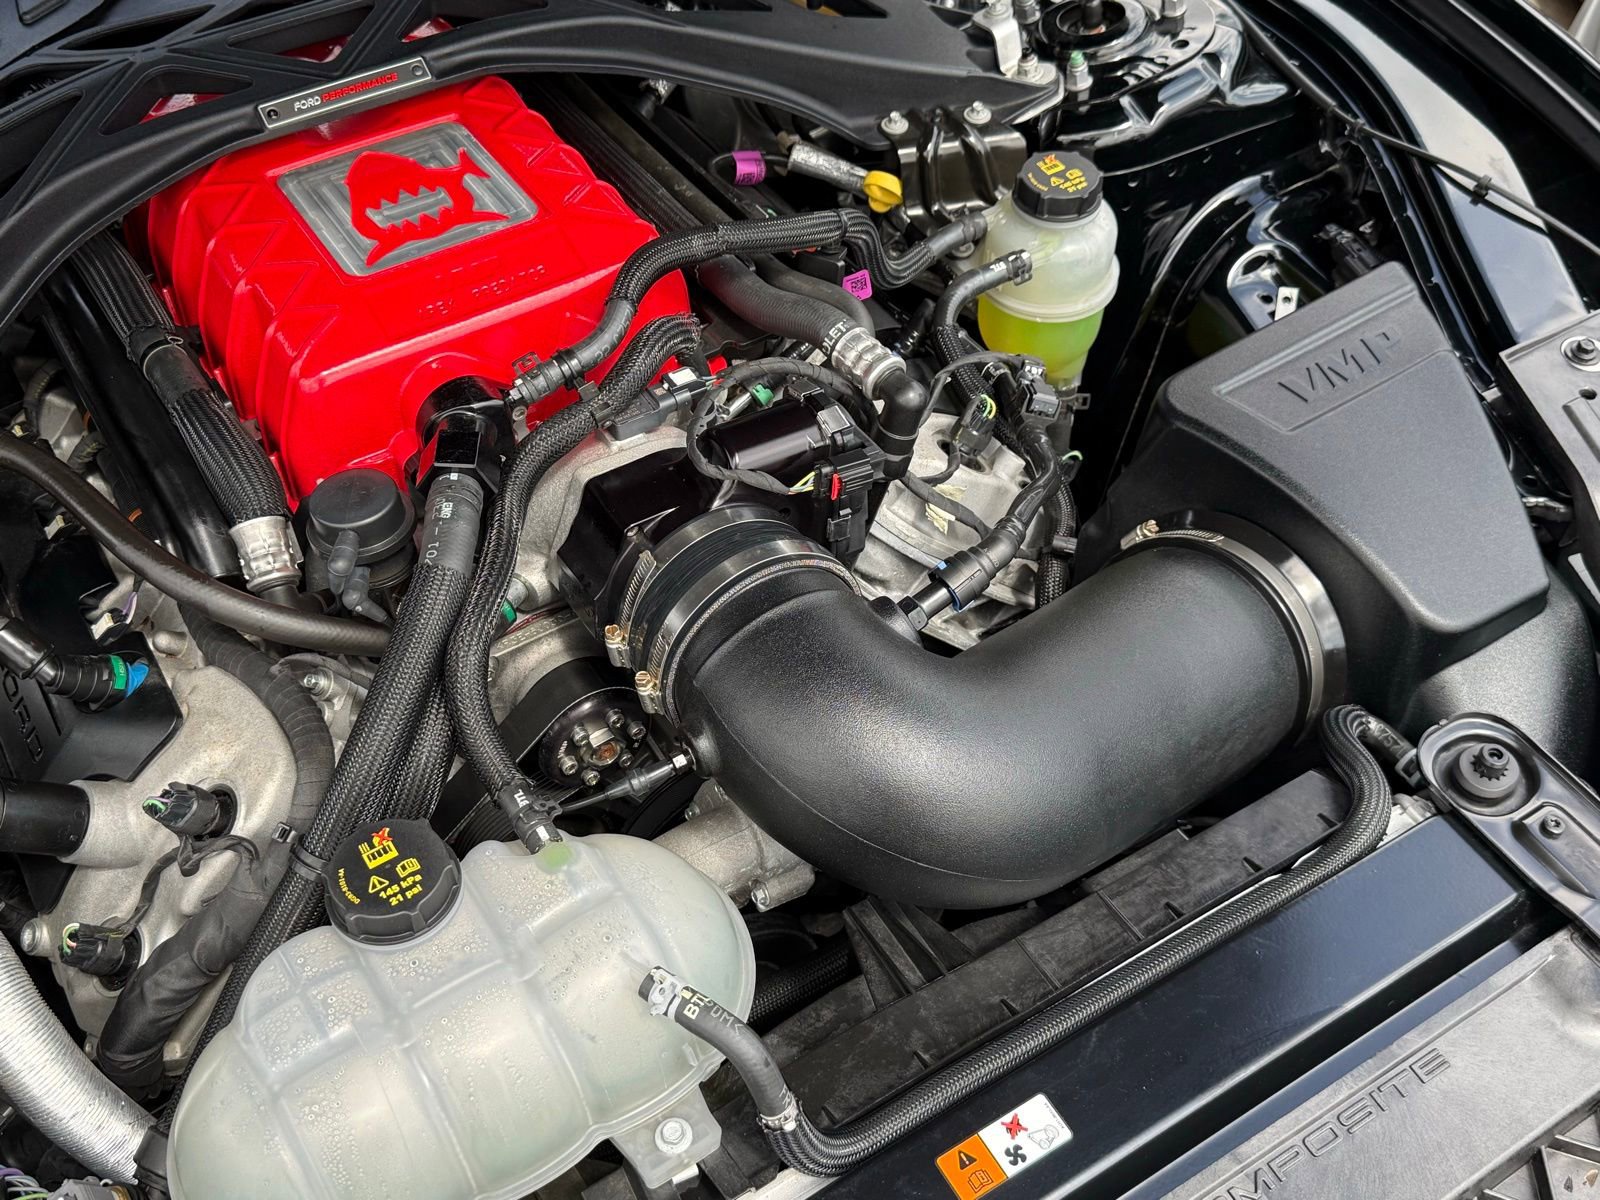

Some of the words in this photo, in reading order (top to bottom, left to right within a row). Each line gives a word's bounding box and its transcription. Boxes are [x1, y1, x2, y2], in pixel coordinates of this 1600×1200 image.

[294, 96, 322, 111] FORD
[320, 72, 398, 103] PERFORMANCE
[1277, 326, 1401, 404] VMP
[379, 884, 401, 899] 145
[400, 874, 423, 889] kPa
[389, 894, 404, 906] 21
[405, 884, 423, 899] psi
[1203, 1047, 1451, 1200] MPOSITE
